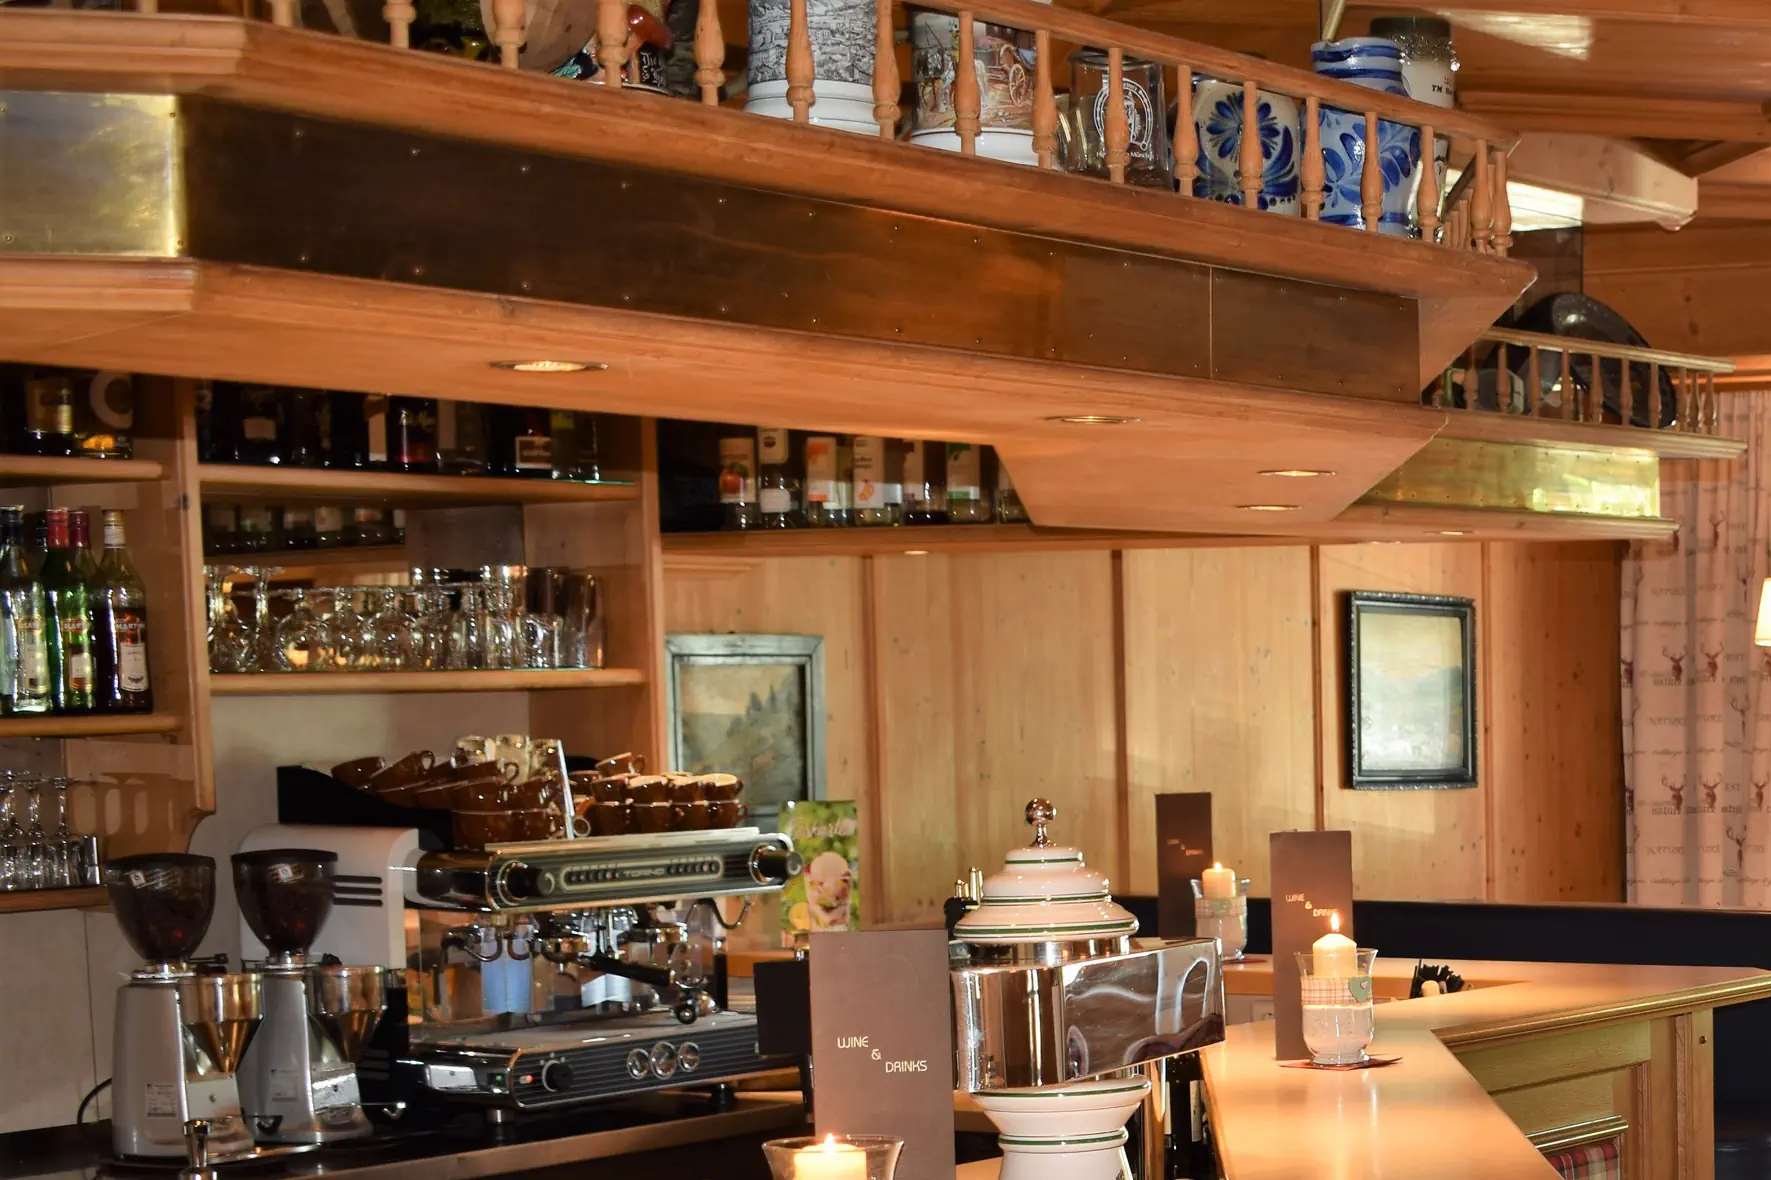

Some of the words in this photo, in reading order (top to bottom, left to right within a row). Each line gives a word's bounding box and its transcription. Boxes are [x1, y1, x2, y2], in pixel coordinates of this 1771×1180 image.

[837, 1036, 869, 1049] WINE
[871, 1048, 882, 1060] &
[885, 1060, 928, 1073] DRINKS
